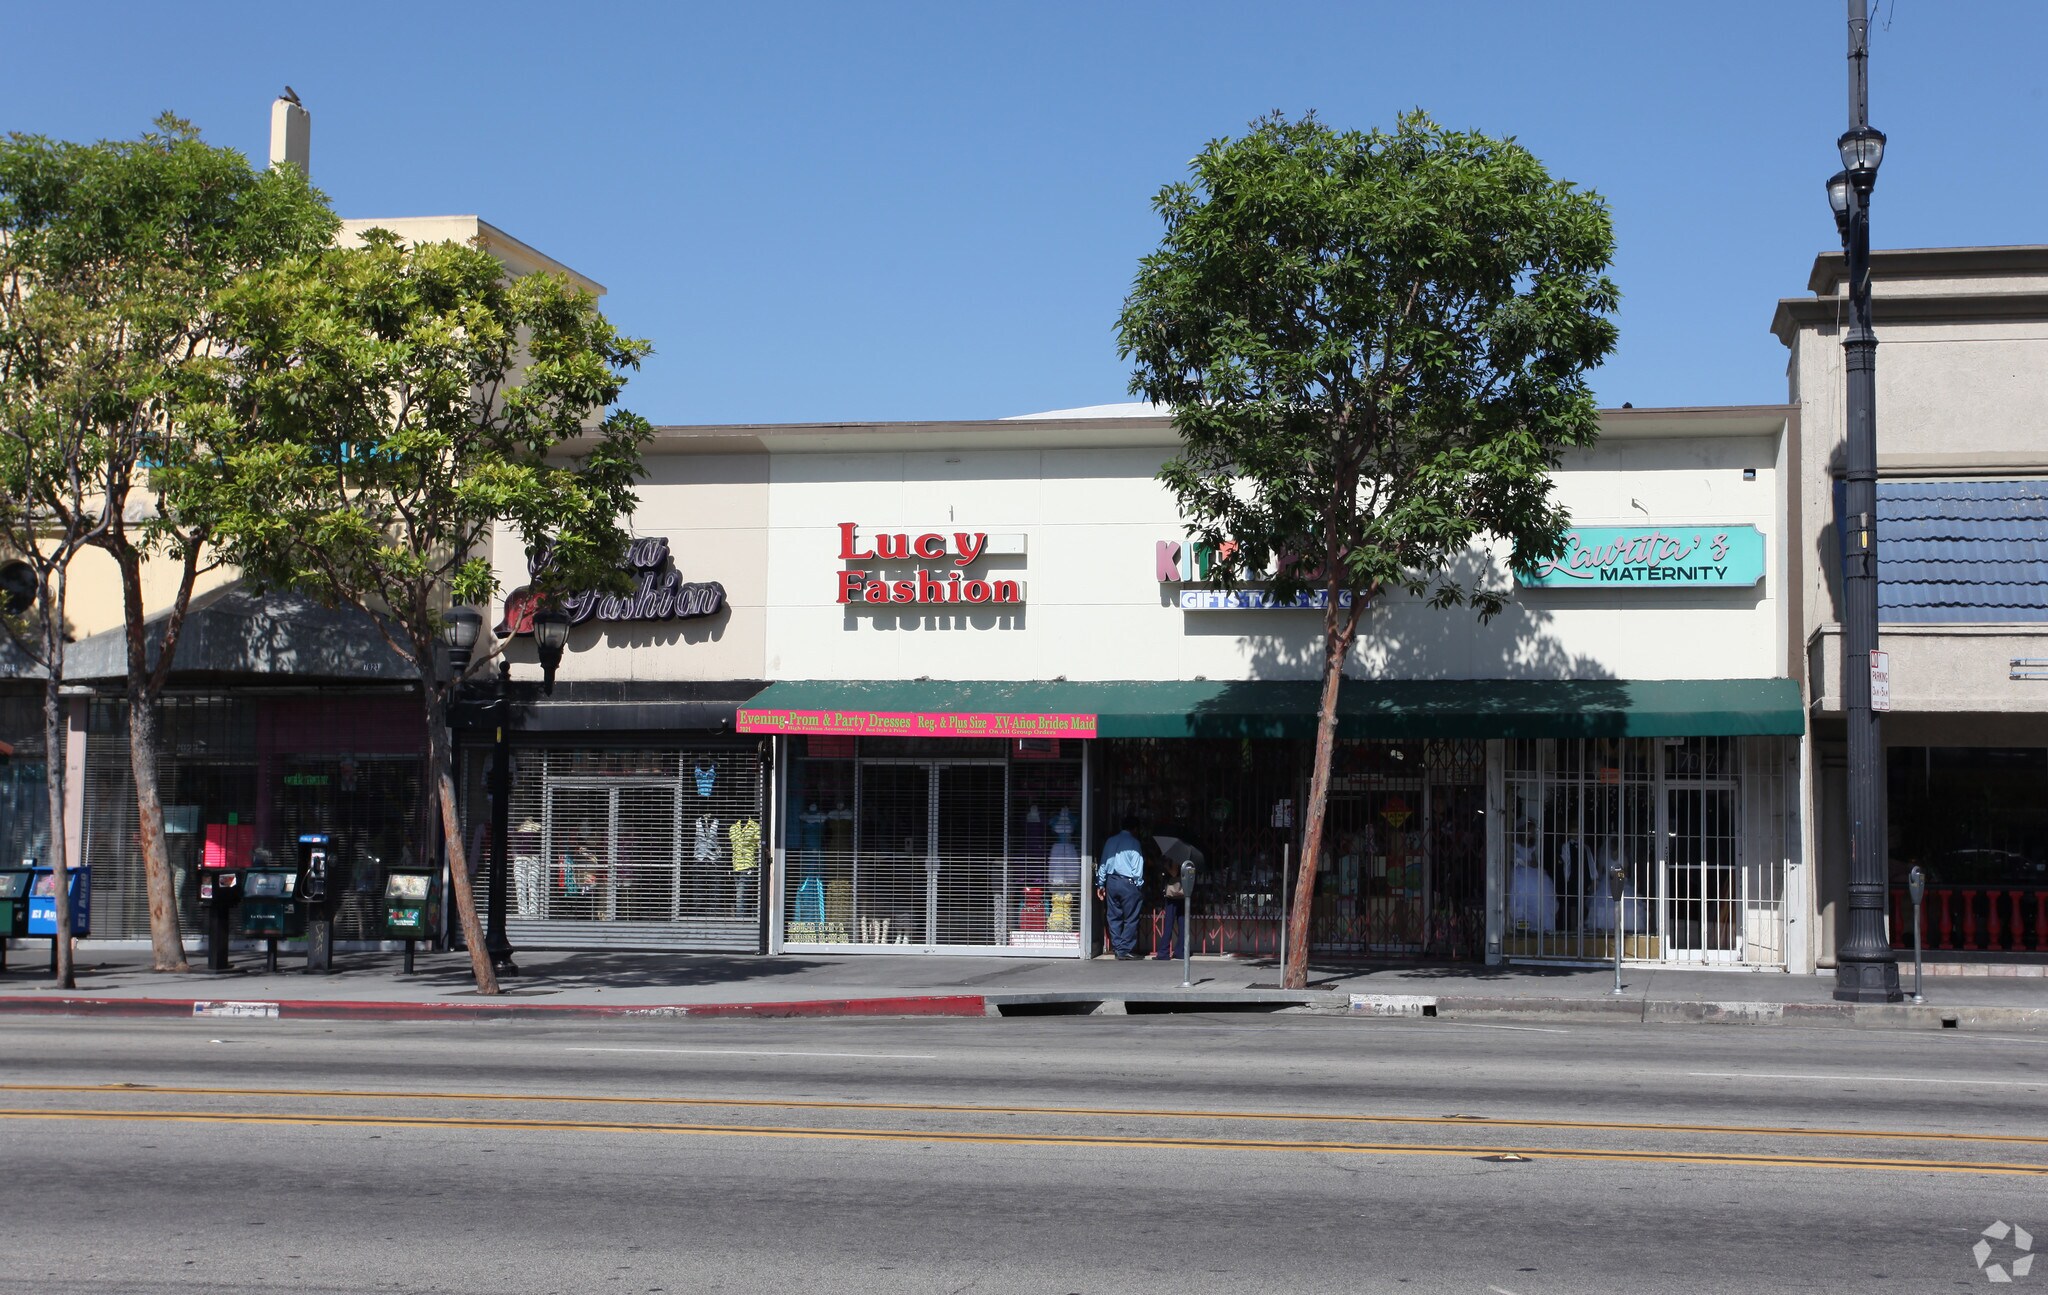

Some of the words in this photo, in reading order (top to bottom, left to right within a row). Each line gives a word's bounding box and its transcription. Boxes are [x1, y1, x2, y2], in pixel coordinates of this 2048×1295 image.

[837, 522, 987, 566] Lucy
[1600, 566, 1728, 581] MATERNITY
[836, 569, 1021, 603] Fashion
[1245, 592, 1303, 608] TOS
[823, 713, 831, 726] &
[834, 712, 866, 731] Party
[869, 713, 911, 729] Dresses
[917, 716, 937, 733] Reg.
[940, 716, 947, 728] &
[949, 716, 968, 729] Plus
[969, 716, 987, 729] Size
[1038, 716, 1068, 730] Brides
[1070, 716, 1096, 730] Maid
